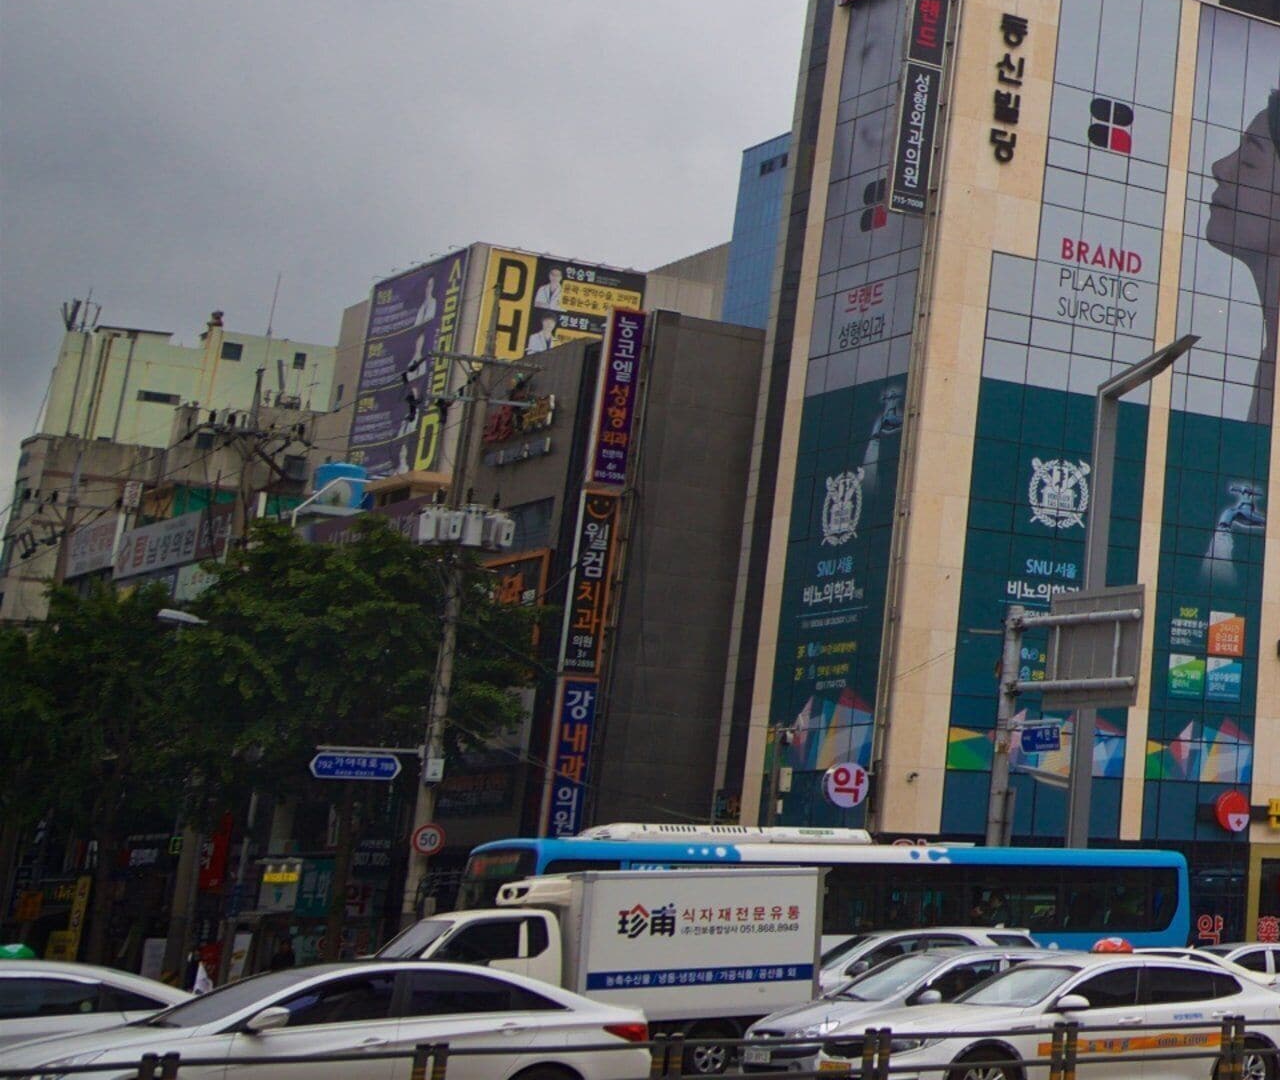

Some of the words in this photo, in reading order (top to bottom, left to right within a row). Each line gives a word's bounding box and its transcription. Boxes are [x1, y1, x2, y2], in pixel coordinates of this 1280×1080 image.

[1062, 238, 1141, 274] BRAND
[845, 283, 884, 313] 브랜드
[1059, 268, 1139, 302] PLASTIC
[1057, 299, 1137, 330] SURGERY
[839, 314, 885, 348] 성형외과
[817, 560, 836, 577] SNU
[838, 556, 854, 574] 서울
[1026, 559, 1052, 575] SNU
[1054, 562, 1076, 579] 서울
[803, 579, 855, 606] 비뇨의학과
[833, 767, 865, 804] 약
[420, 834, 436, 846] 50
[682, 905, 800, 922] 식자재전문유통
[1197, 915, 1223, 945] 약
